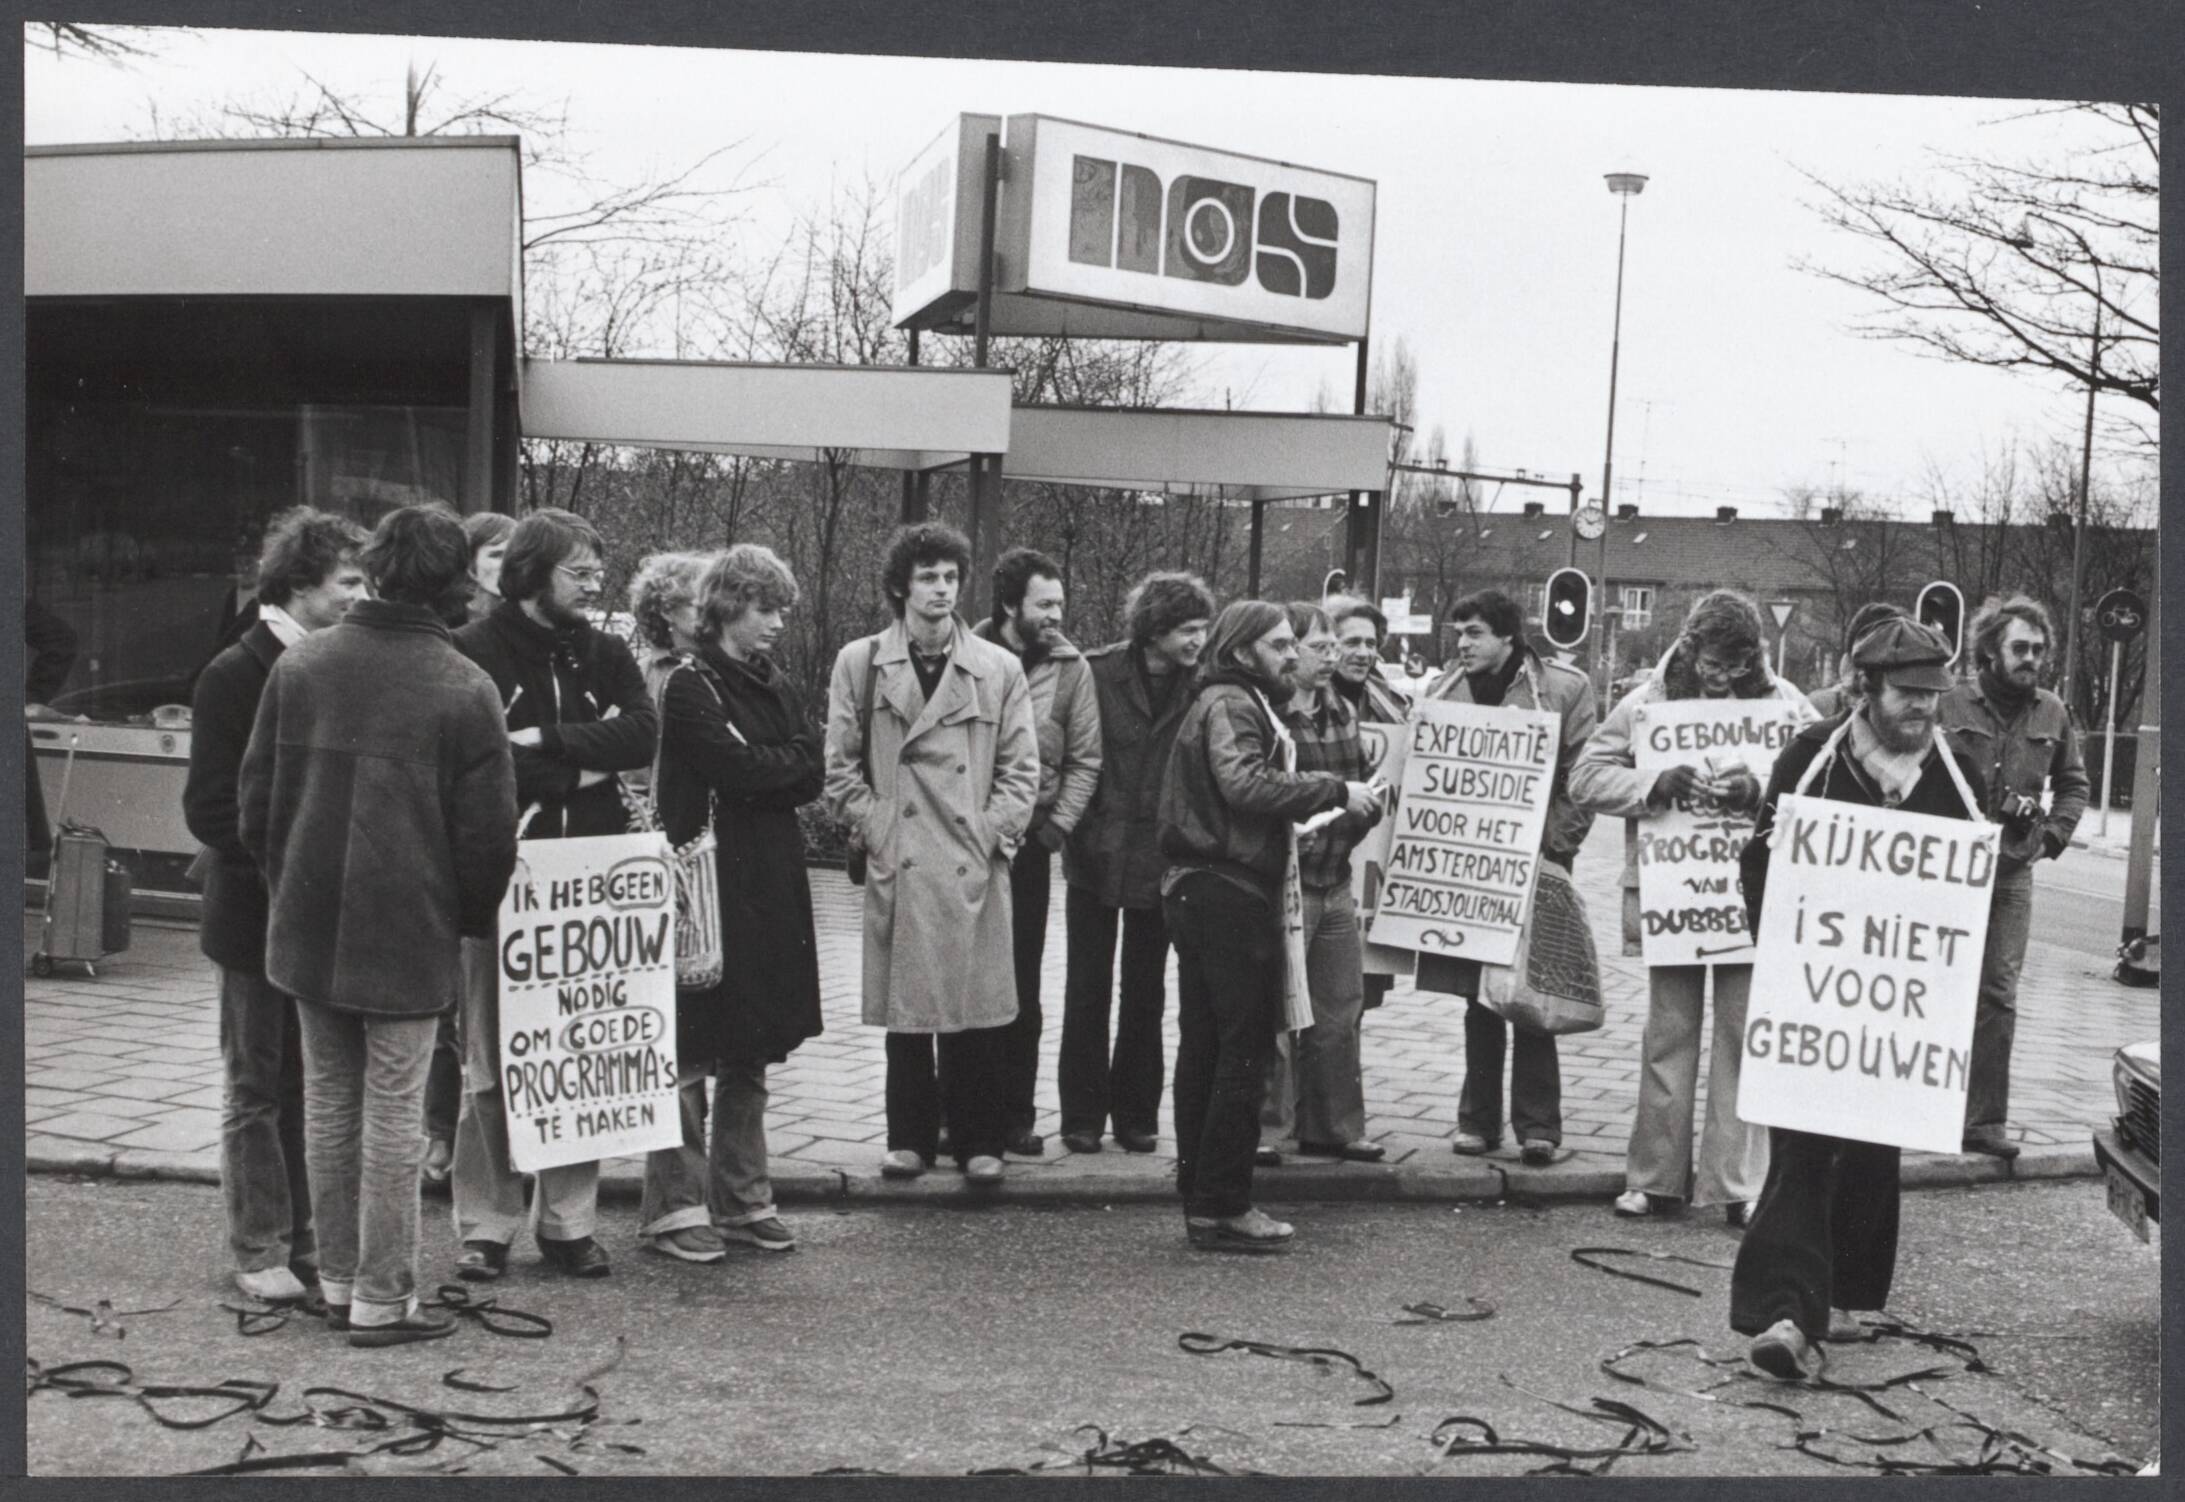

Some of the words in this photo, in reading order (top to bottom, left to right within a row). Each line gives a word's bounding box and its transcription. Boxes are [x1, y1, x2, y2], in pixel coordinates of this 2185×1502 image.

[1423, 763, 1540, 804] SUBSIDIE
[1406, 807, 1468, 837] VOOR
[1476, 818, 1523, 844] HET
[1389, 842, 1531, 887] AMSTERDAMS
[513, 883, 539, 913] IK
[549, 875, 604, 911] HEB
[609, 871, 664, 900] GEEN
[1383, 882, 1524, 926] STADSJOURNAAL
[503, 913, 669, 981] GEBOUW
[1804, 961, 1926, 1019] VOOR
[509, 1028, 550, 1056] OM
[569, 1012, 652, 1049] GOEDE
[1747, 1017, 1968, 1092] GEBOUWEN
[506, 1045, 677, 1112] PROGRAMMA'S
[534, 1115, 562, 1144] TE
[576, 1103, 654, 1138] MAKEN
